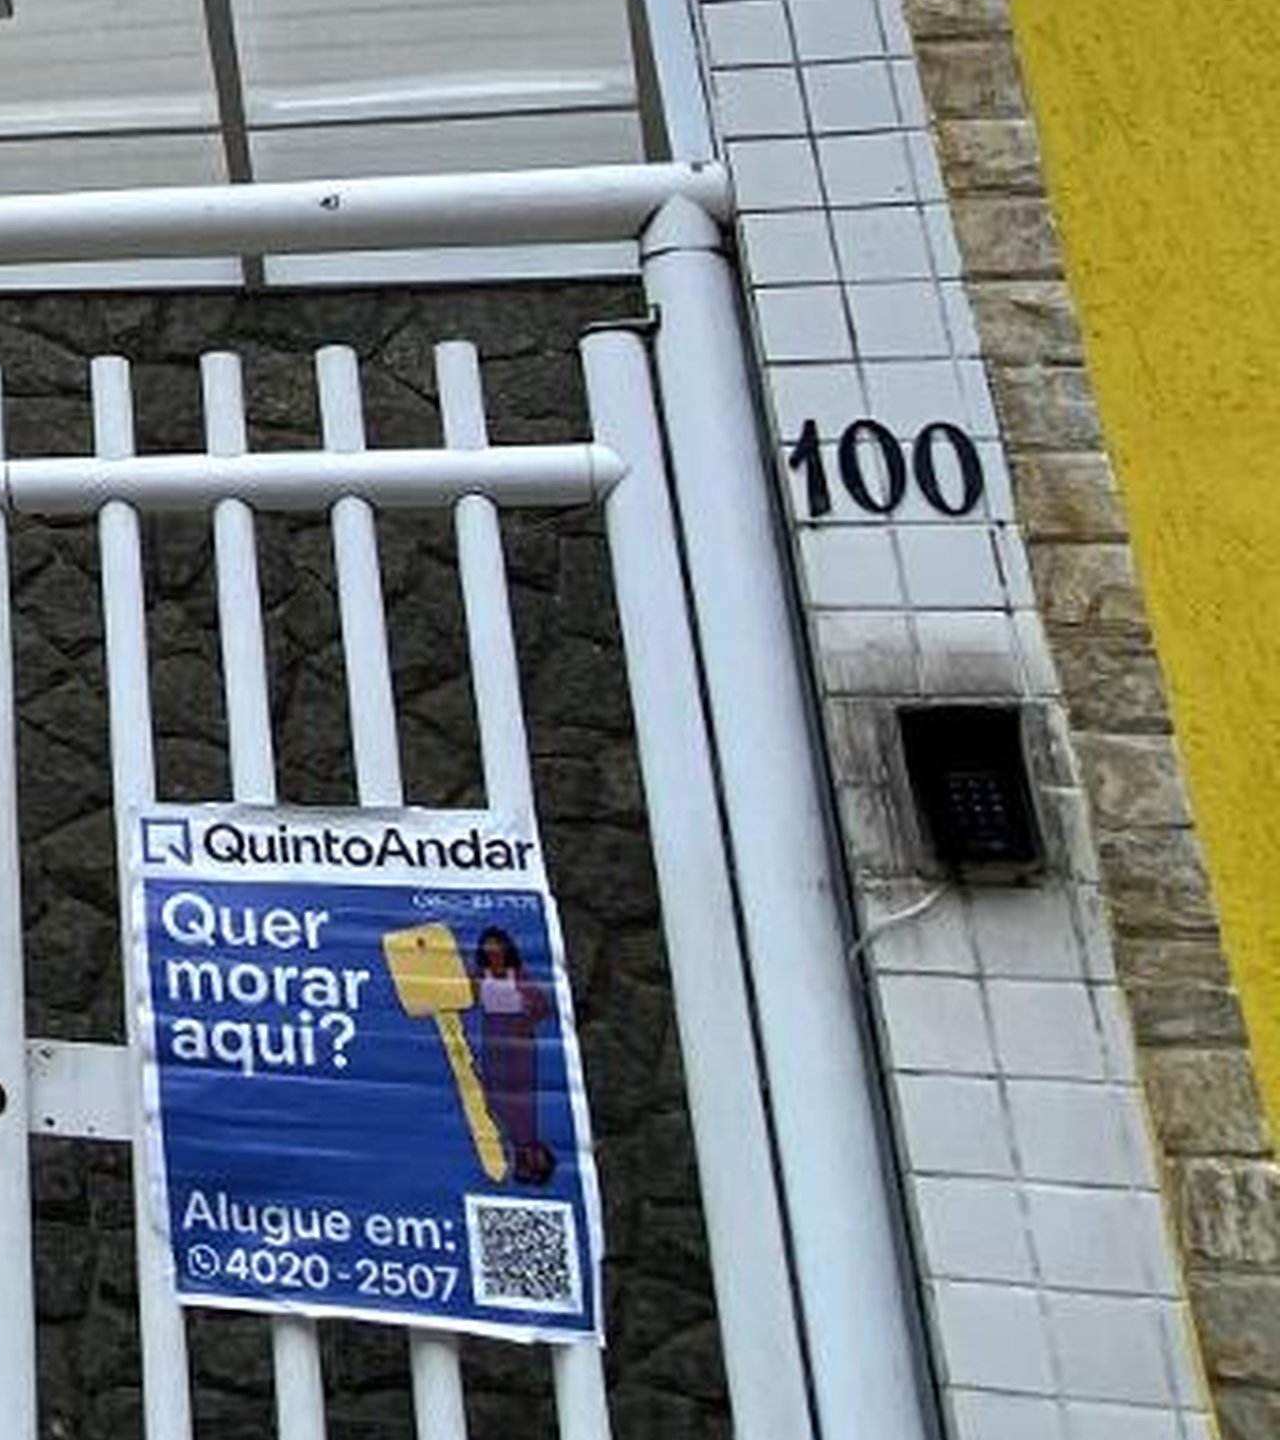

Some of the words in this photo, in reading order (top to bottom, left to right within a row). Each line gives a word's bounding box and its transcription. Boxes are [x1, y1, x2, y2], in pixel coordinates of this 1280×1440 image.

[788, 419, 985, 517] 100
[203, 823, 533, 871] QuintoAndar
[162, 893, 329, 949] Quer
[168, 957, 369, 1010] morar
[171, 1012, 355, 1076] aqui?
[183, 1191, 351, 1246] Alugue
[365, 1214, 457, 1252] em:
